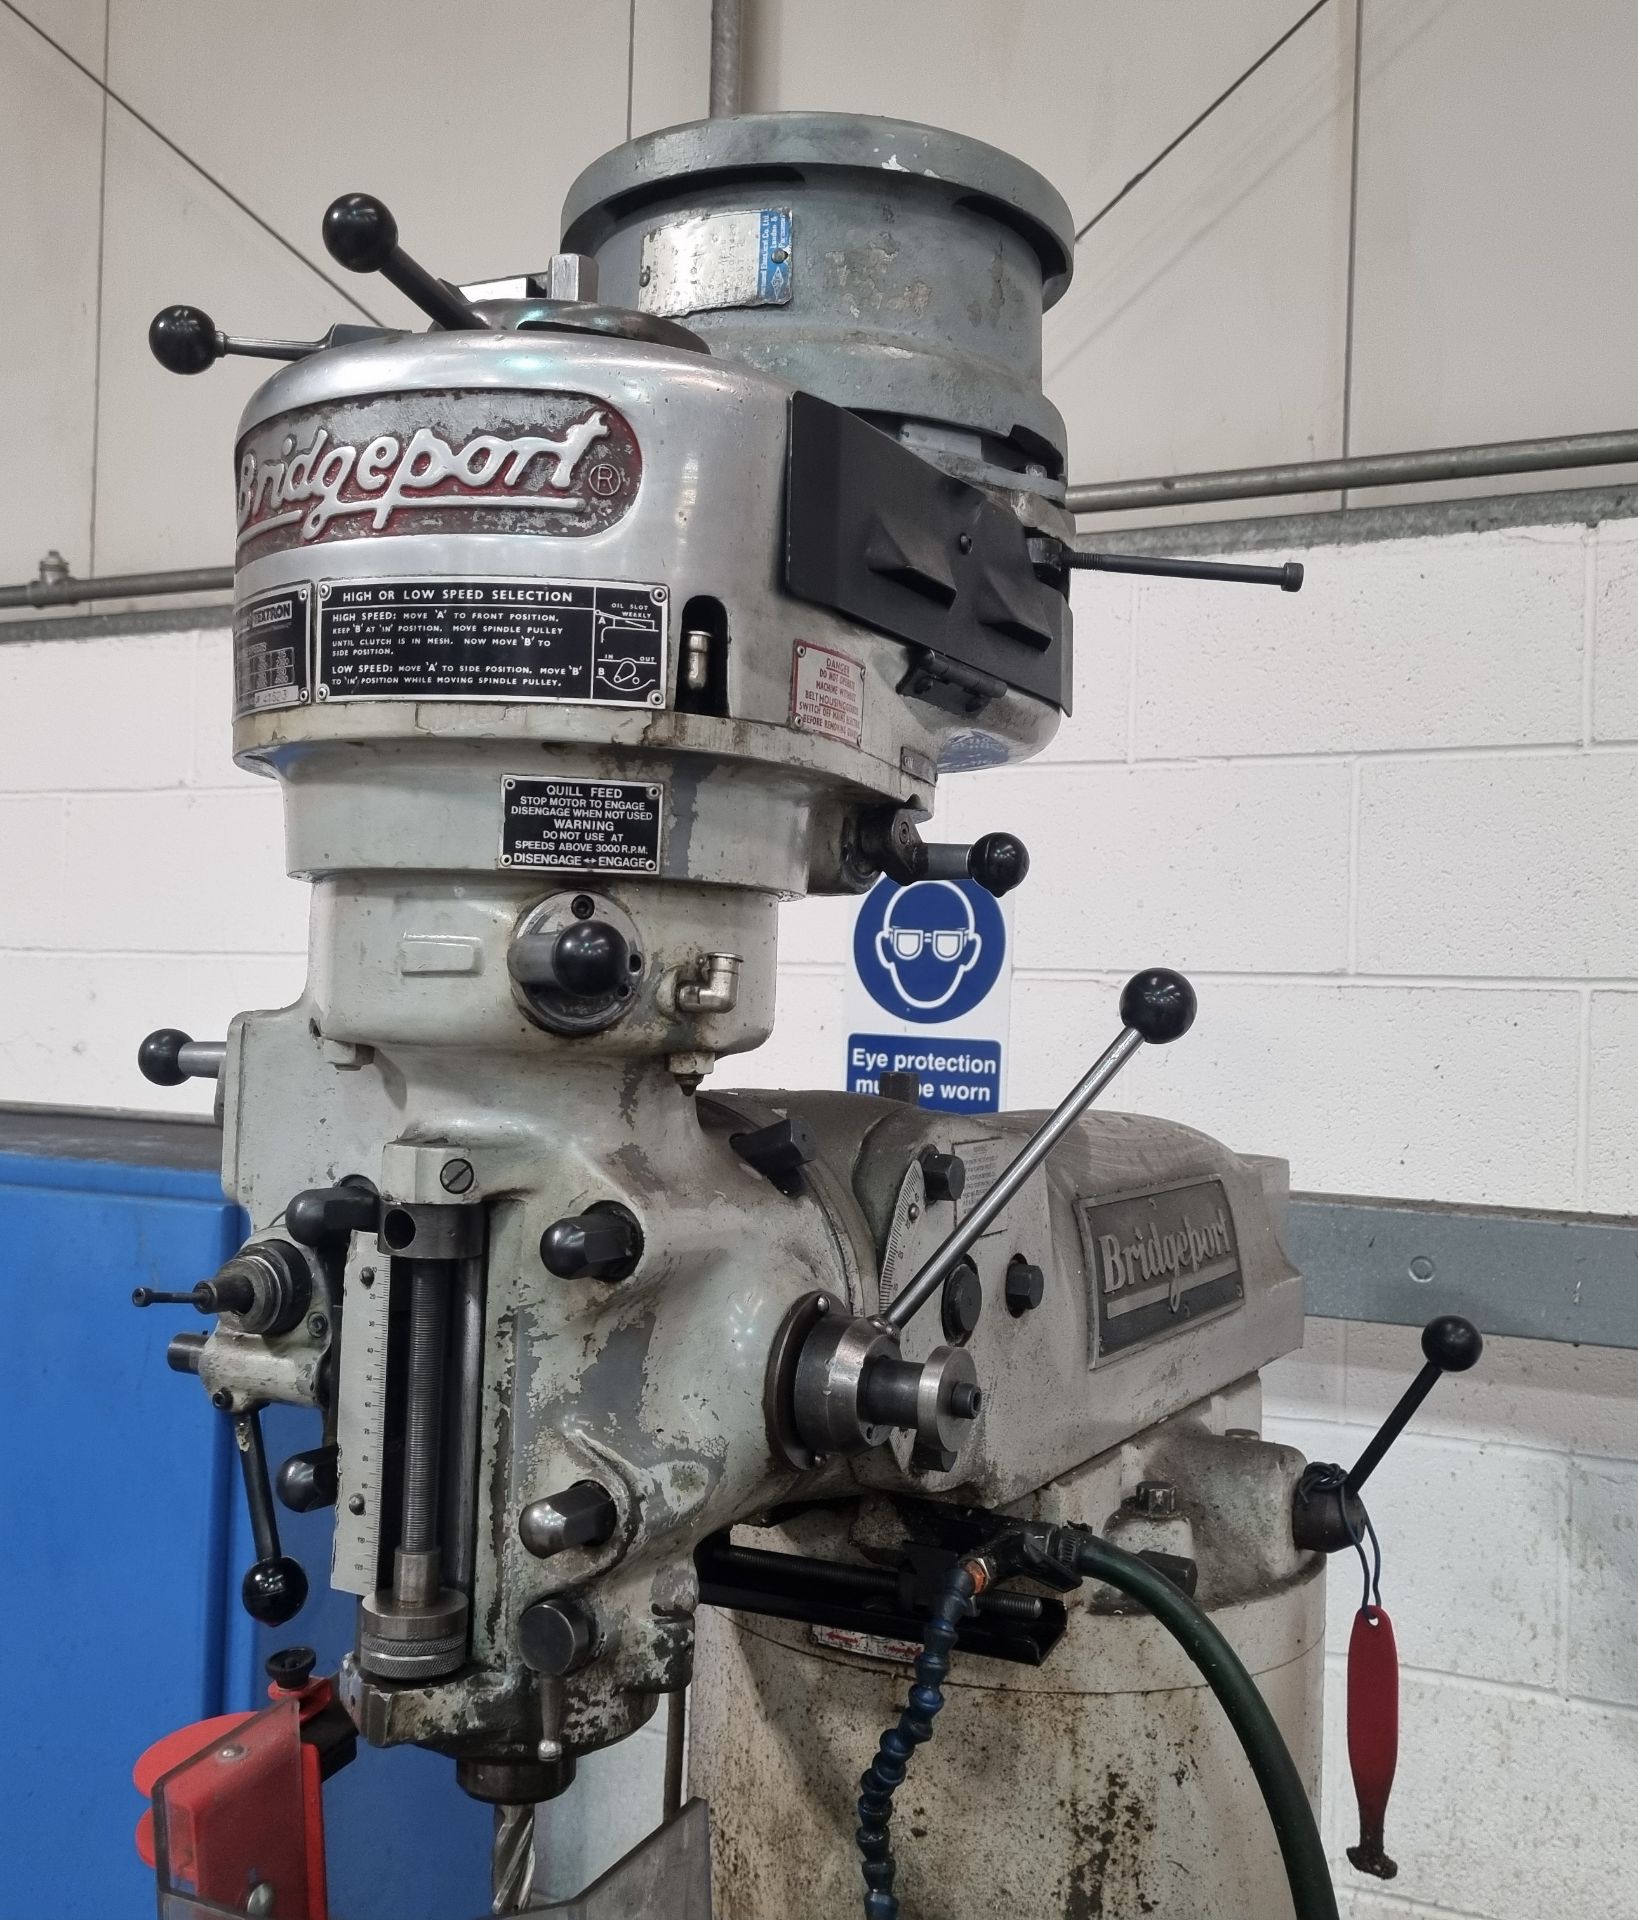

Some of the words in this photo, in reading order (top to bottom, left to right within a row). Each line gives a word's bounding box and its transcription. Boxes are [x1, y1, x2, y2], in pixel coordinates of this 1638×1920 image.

[238, 410, 609, 540] Bridgeport
[343, 591, 372, 602] HIGH
[379, 590, 395, 600] OR
[403, 590, 435, 600] LOW
[442, 590, 484, 600] SPEED
[492, 590, 573, 602] SELECTION
[332, 613, 356, 622] HIGH
[362, 612, 397, 621] SPEED:
[403, 612, 428, 620] MOVE
[472, 612, 504, 620] FRONT
[510, 613, 559, 622] POSITION.
[598, 616, 606, 624] A
[452, 624, 477, 632] MOVE
[527, 626, 564, 635] PULLEY
[332, 639, 354, 647] UNTIL
[360, 638, 392, 646] CLUTCH
[492, 638, 518, 646] MOVE
[332, 649, 349, 657] SIDE
[332, 665, 354, 674] LOW
[358, 664, 393, 673] SPEED:
[486, 666, 533, 674] POSITION.
[540, 667, 566, 675] MOVE
[826, 658, 850, 674] DANGER
[361, 676, 399, 684] POSITION
[404, 676, 432, 684] WHILE
[437, 676, 473, 684] MOVING
[820, 669, 828, 678] DO
[828, 671, 838, 682] NOT
[816, 681, 838, 694] MACHINE
[805, 690, 819, 703] BELT
[819, 694, 846, 711] HOUSING
[799, 702, 822, 714] SWITCH
[822, 708, 832, 718] OFF
[802, 714, 823, 727] BEFORE
[546, 785, 583, 797] QUILL
[590, 788, 622, 798] FEED
[520, 796, 548, 806] STOP
[550, 798, 587, 808] MOTOR
[588, 800, 602, 809] TO
[604, 801, 646, 811] ENGAGE
[511, 806, 571, 817] DISENGAGE
[572, 809, 602, 818] WHEN
[604, 810, 626, 820] NOT
[626, 812, 653, 821] USED
[554, 819, 614, 832] WARNING
[543, 831, 558, 840] DO
[560, 831, 581, 841] NOT
[584, 832, 605, 842] USE
[611, 834, 624, 842] AT
[514, 840, 556, 851] SPEEDS
[558, 842, 593, 852] ABOVE
[596, 844, 620, 853] 3000
[514, 853, 582, 866] DISENGAGE
[598, 856, 646, 868] ENGAGE
[852, 1048, 888, 1072] Eye
[894, 1051, 996, 1074] protection
[940, 1084, 991, 1102] worn
[1099, 1209, 1231, 1313] Bridgeport
[368, 1320, 375, 1328] 30
[366, 1374, 372, 1382] 50
